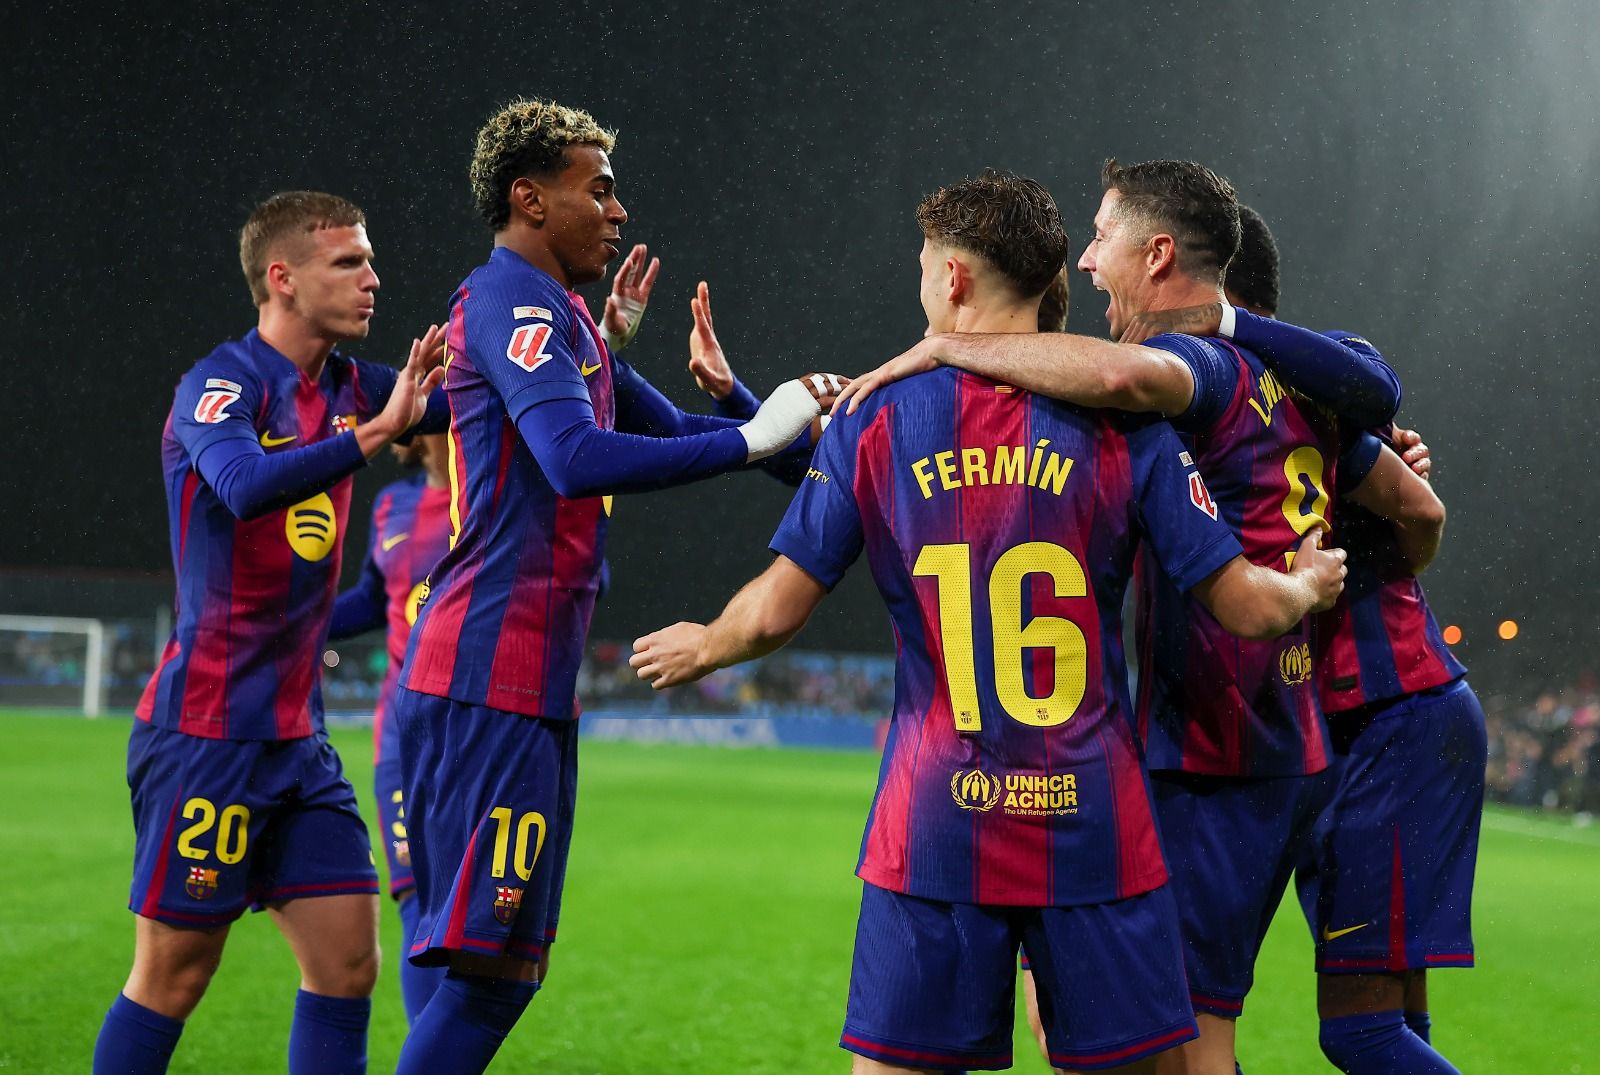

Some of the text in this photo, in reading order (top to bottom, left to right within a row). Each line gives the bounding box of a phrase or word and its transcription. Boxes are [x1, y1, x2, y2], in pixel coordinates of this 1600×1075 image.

[911, 438, 1075, 499] FERMÍN
[912, 541, 1088, 733] 16
[1003, 791, 1078, 809] ACNUR
[1005, 774, 1077, 792] UNHCR
[1055, 807, 1078, 816] Agency
[177, 797, 251, 865] 20
[489, 807, 547, 881] 10
